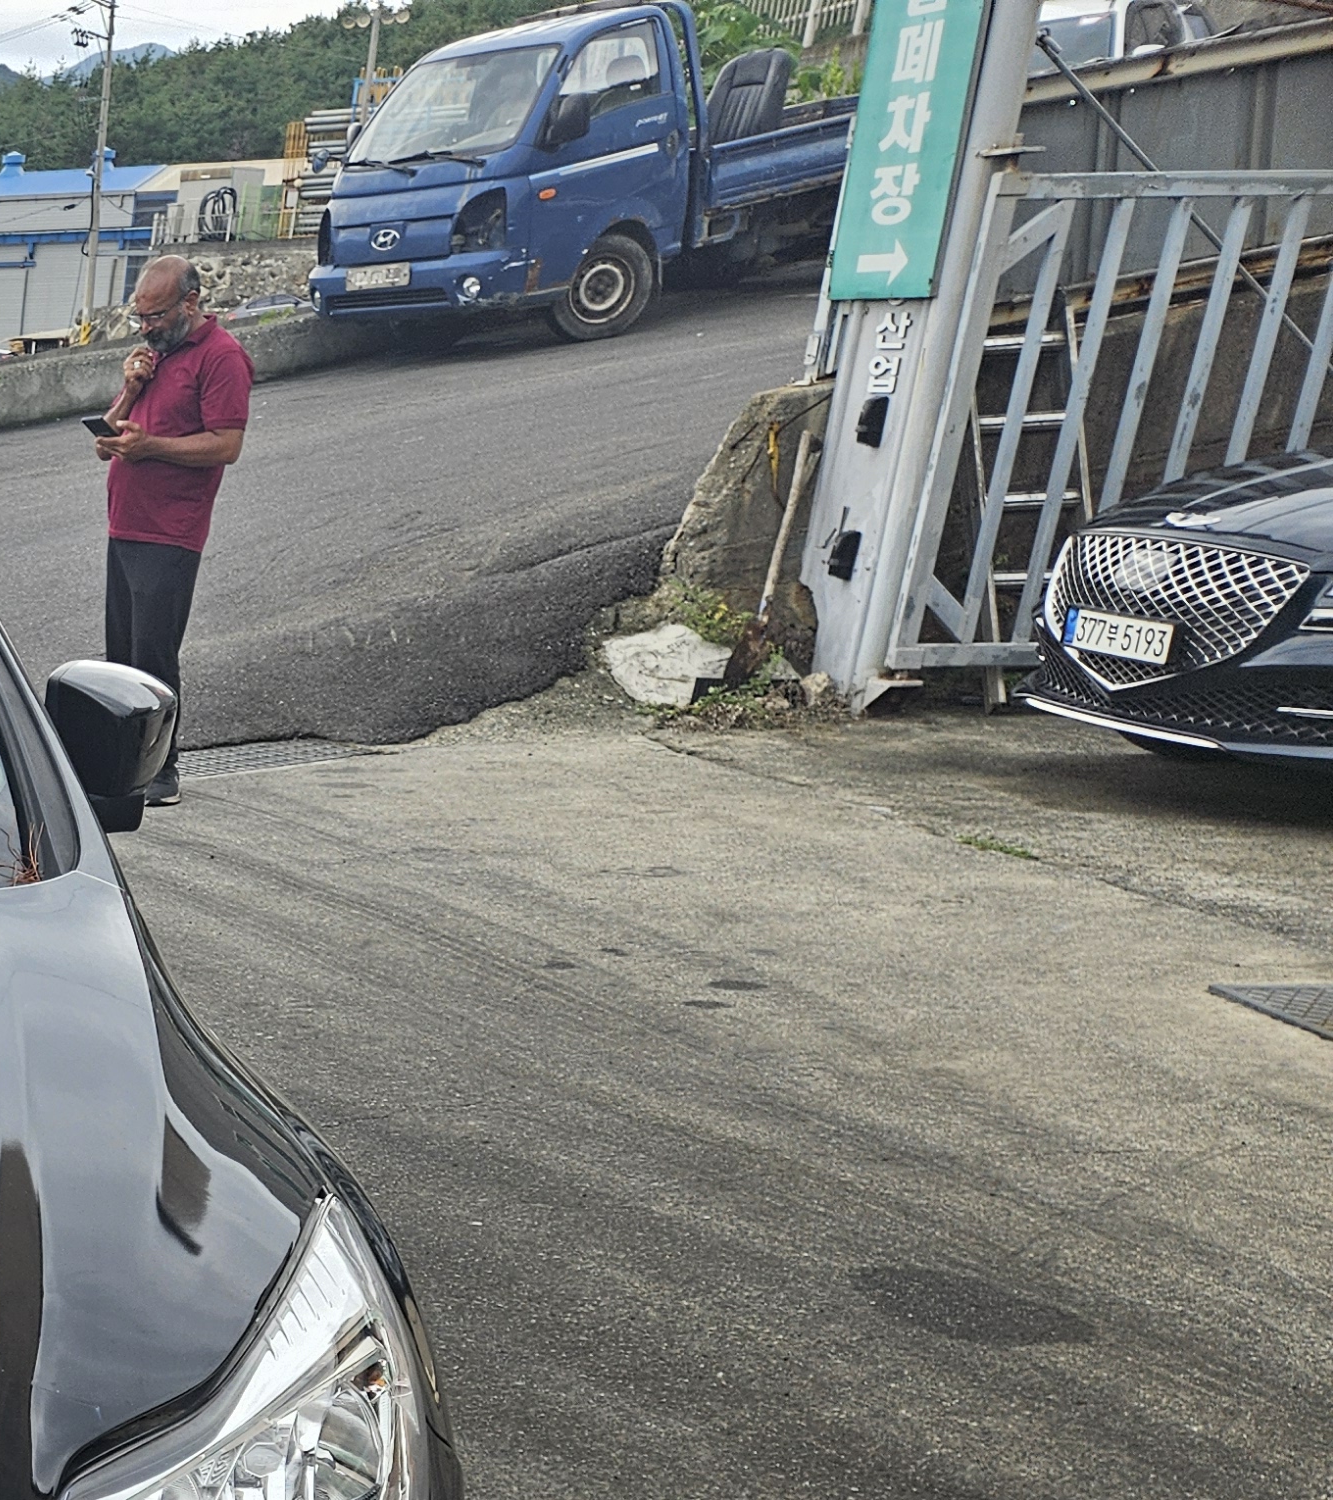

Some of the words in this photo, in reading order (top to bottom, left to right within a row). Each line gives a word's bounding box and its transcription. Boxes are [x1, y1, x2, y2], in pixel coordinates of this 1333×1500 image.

[867, 298, 913, 394] 산업
[1076, 615, 1119, 648] 377부
[1120, 624, 1168, 657] 5193
